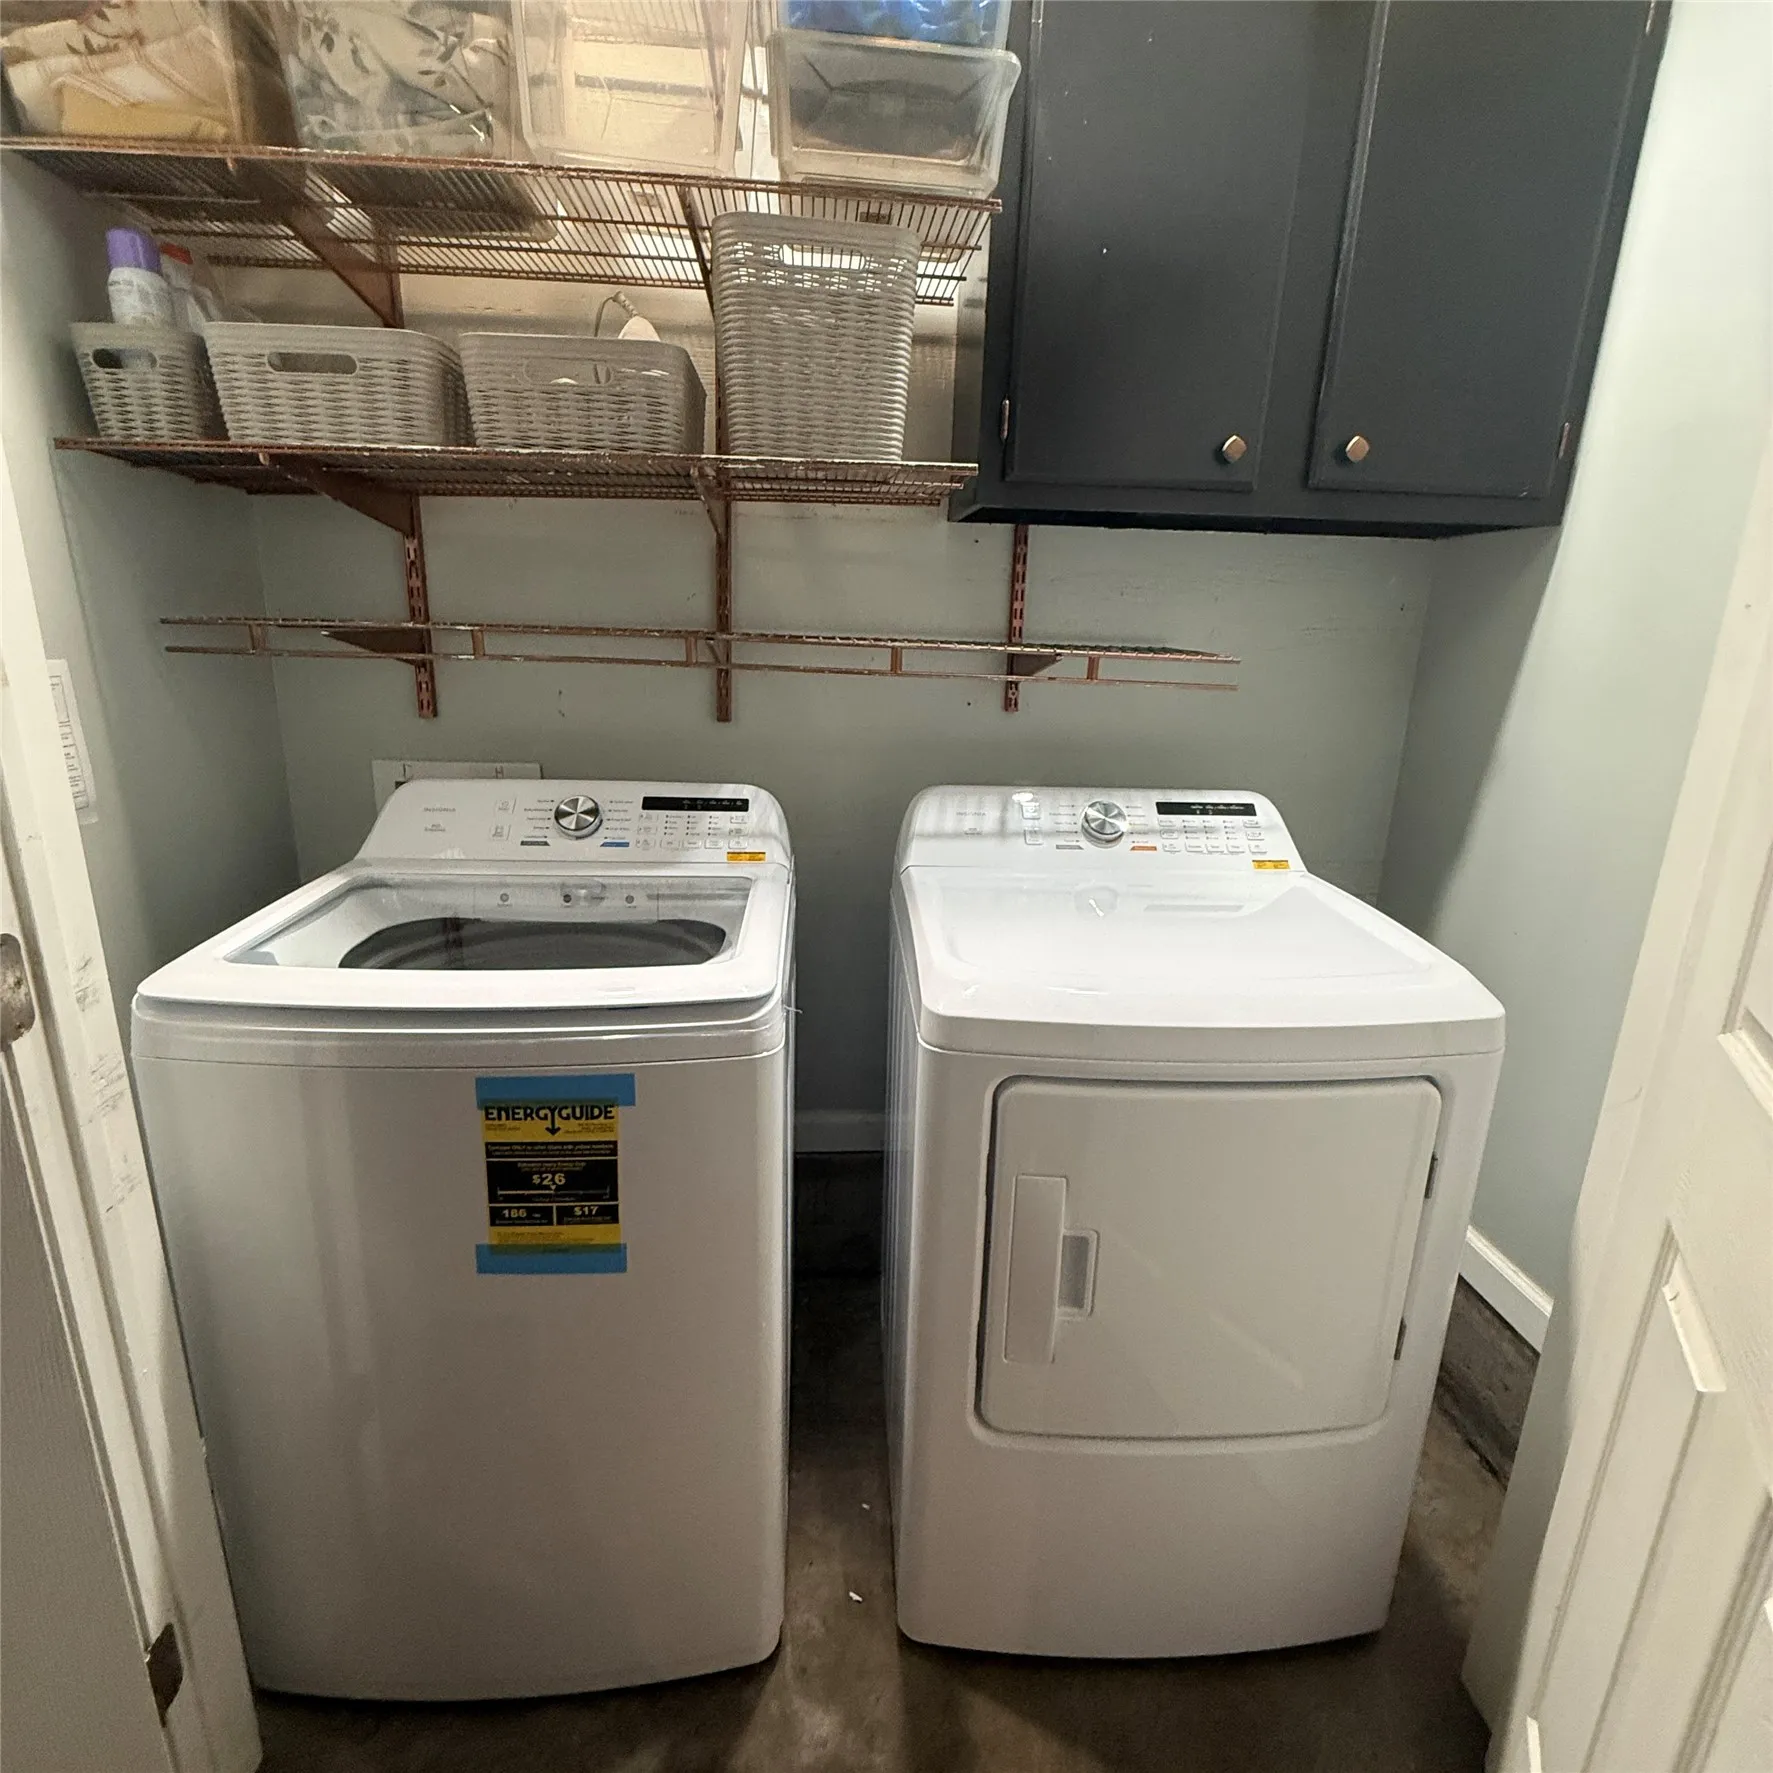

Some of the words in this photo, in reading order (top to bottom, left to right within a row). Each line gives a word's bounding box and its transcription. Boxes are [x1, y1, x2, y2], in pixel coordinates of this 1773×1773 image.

[484, 1104, 616, 1122] ENERGYGUIDE
[532, 1172, 566, 1186] $26
[573, 1205, 600, 1217] $17
